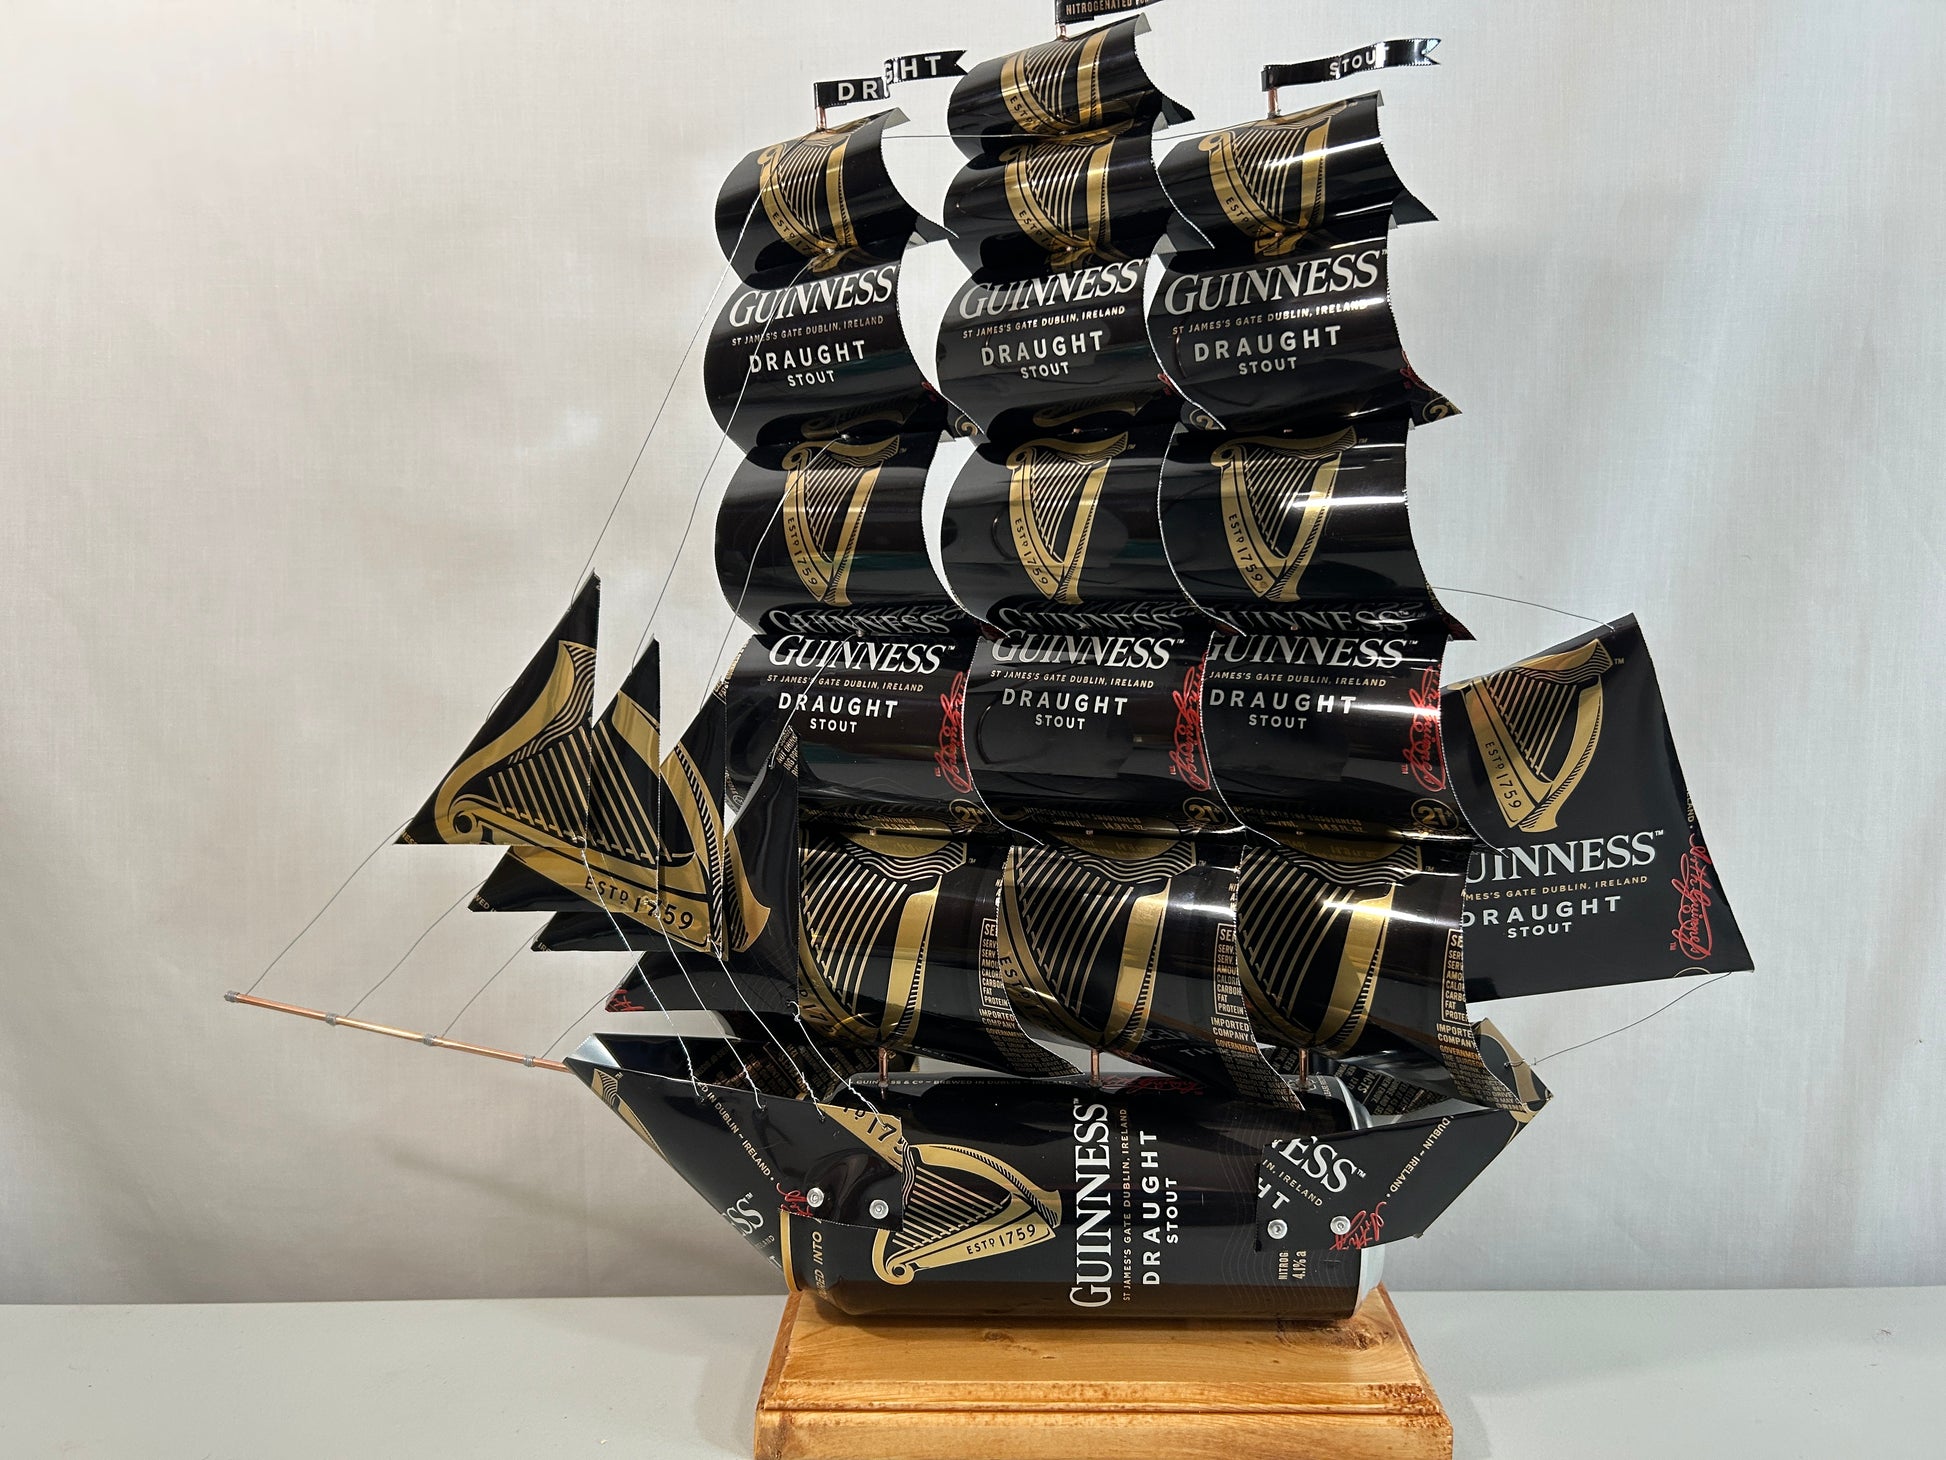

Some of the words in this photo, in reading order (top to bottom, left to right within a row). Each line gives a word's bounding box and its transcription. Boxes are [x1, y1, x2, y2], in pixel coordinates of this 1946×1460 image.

[729, 265, 896, 327] GUINNESS
[959, 259, 1142, 320] GUINNESS
[1164, 249, 1382, 316] GUINNESS
[750, 340, 866, 373] DRAUGHT
[981, 330, 1103, 366] DRAUGHT
[1194, 325, 1342, 362] DRAUGHT
[787, 370, 836, 387] STOUT
[1020, 361, 1070, 379] STOUT
[1238, 357, 1297, 376] STOUT
[794, 551, 818, 586] 1759
[1023, 551, 1049, 586] 1759
[1237, 546, 1263, 583] 1759
[768, 634, 946, 674] GUINNESS
[778, 692, 899, 719] DRAUGHT
[1001, 688, 1128, 716] DRAUGHT
[1209, 689, 1356, 714] DRAUGHT
[809, 718, 858, 734] STOUT
[1034, 713, 1086, 730] STOUT
[1248, 714, 1307, 729] STOUT
[1496, 773, 1522, 808] 1759
[1506, 888, 1537, 897] GATE
[1595, 875, 1648, 889] IRELAND
[1462, 895, 1621, 928] DRAUGHT
[1508, 921, 1572, 938] STOUT
[1211, 1016, 1249, 1031] IMPORTED
[1213, 1027, 1248, 1042] COMPANY
[1436, 1023, 1473, 1039] IMPORTE
[714, 1102, 740, 1134] DUBLIN
[742, 1139, 772, 1176] IRELAND
[1120, 1108, 1129, 1154] IRELAND
[1423, 1116, 1451, 1150] DUBLIN
[1278, 1171, 1323, 1207] IRELAND
[1389, 1155, 1421, 1193] IRELAND
[1069, 1103, 1112, 1308] GUINNESS
[1140, 1130, 1161, 1285] DRAUGHT
[1165, 1177, 1179, 1244] STOUT
[1000, 1223, 1036, 1247] 1759
[1123, 1213, 1132, 1244] GATE
[812, 1231, 823, 1266] INTO
[1292, 1259, 1306, 1281] 4.1%
